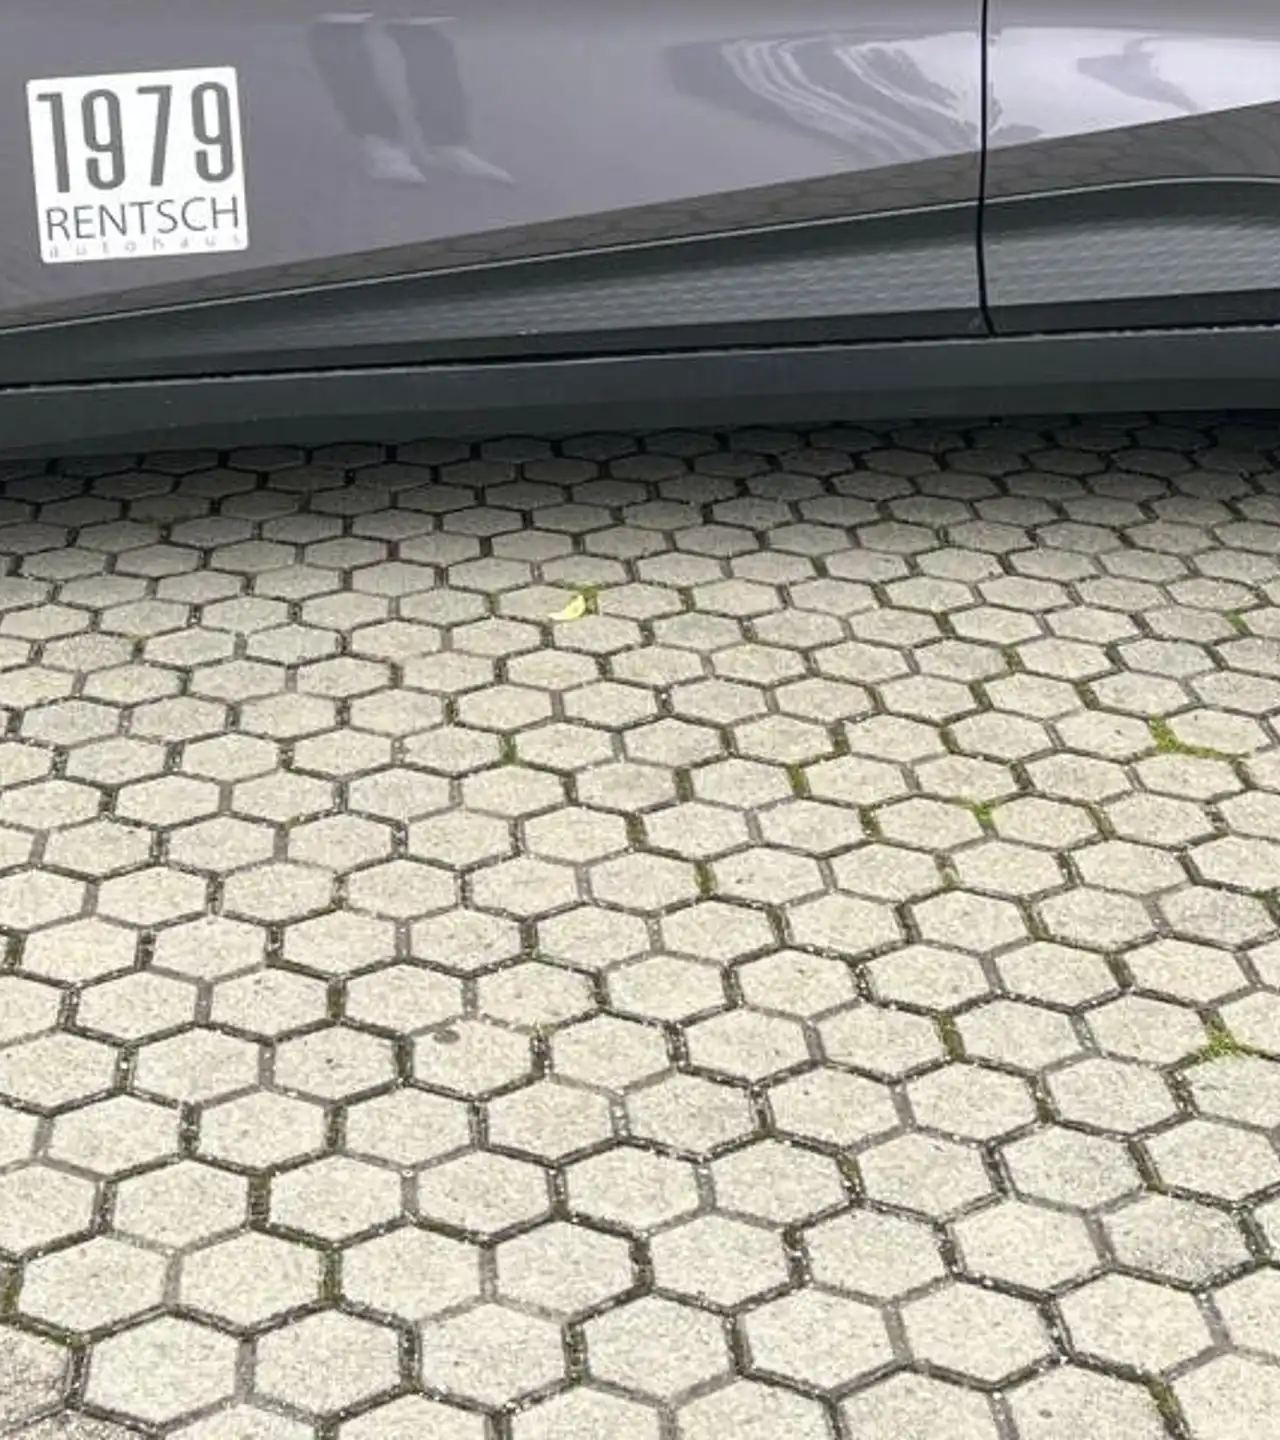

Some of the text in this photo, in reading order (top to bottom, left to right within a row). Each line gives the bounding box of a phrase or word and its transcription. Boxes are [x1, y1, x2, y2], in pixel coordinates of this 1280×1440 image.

[36, 81, 235, 193] 1979
[45, 194, 239, 241] RENTSCH
[48, 233, 242, 258] autohaus
